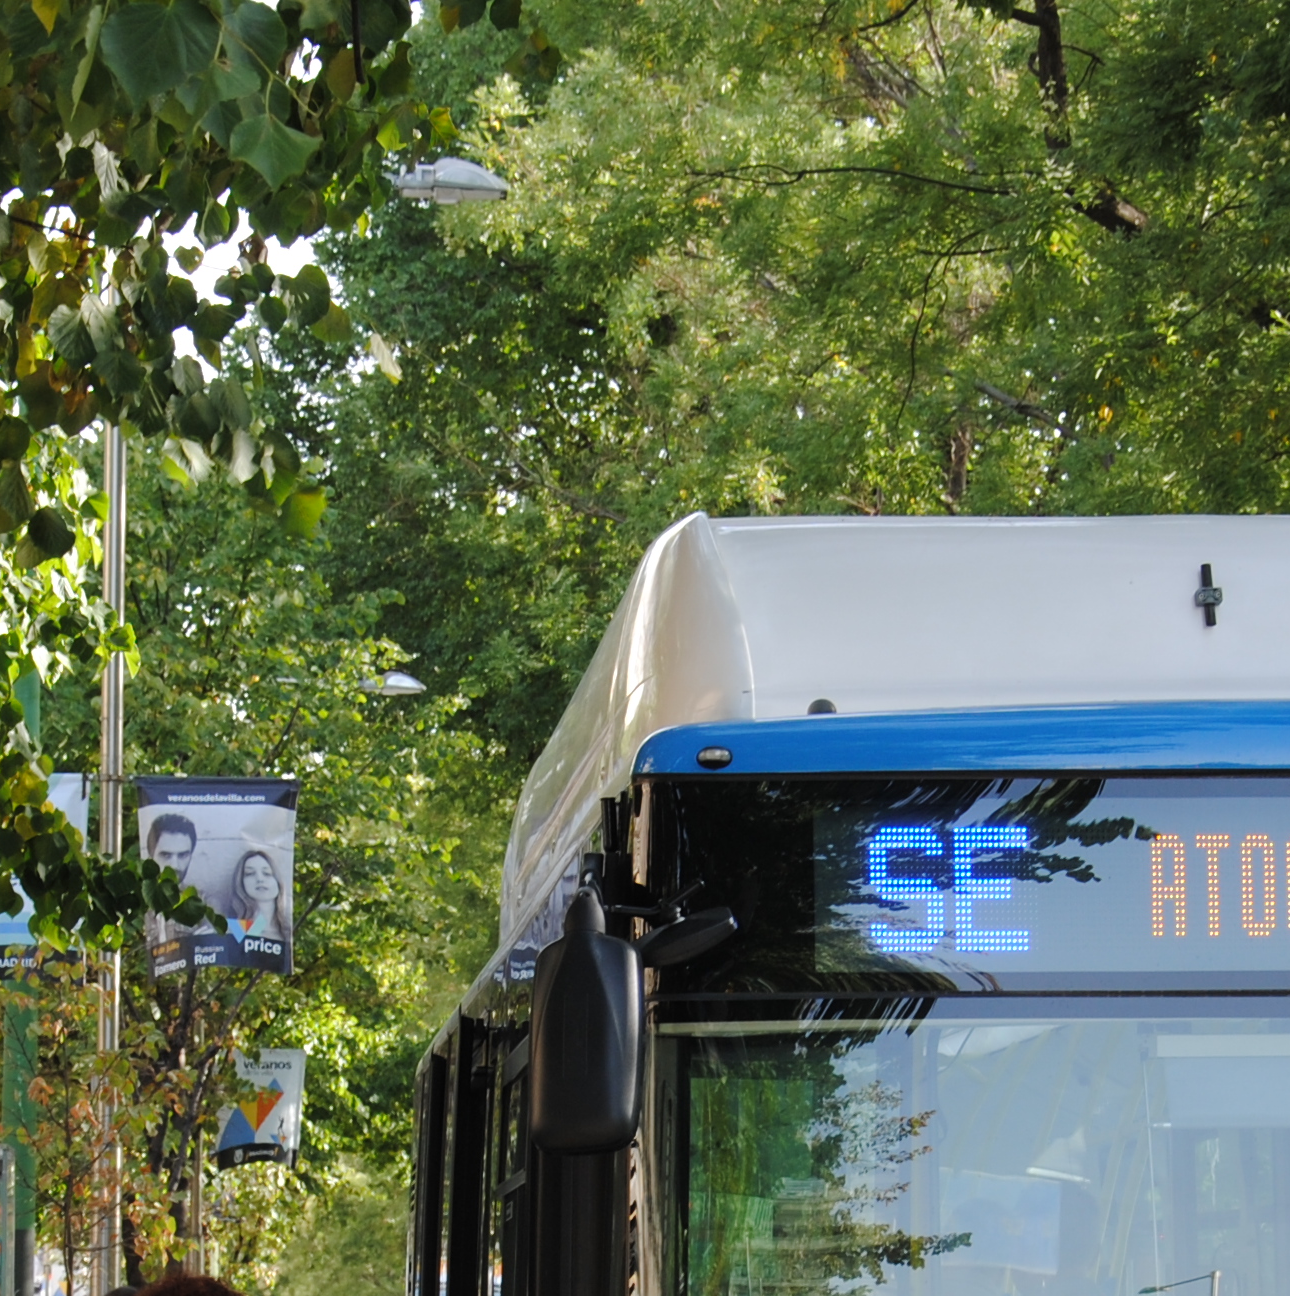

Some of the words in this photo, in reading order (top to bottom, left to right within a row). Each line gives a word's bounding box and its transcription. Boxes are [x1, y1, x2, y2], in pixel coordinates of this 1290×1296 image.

[869, 826, 1030, 952] SE
[244, 938, 282, 955] price
[194, 952, 216, 966] Red
